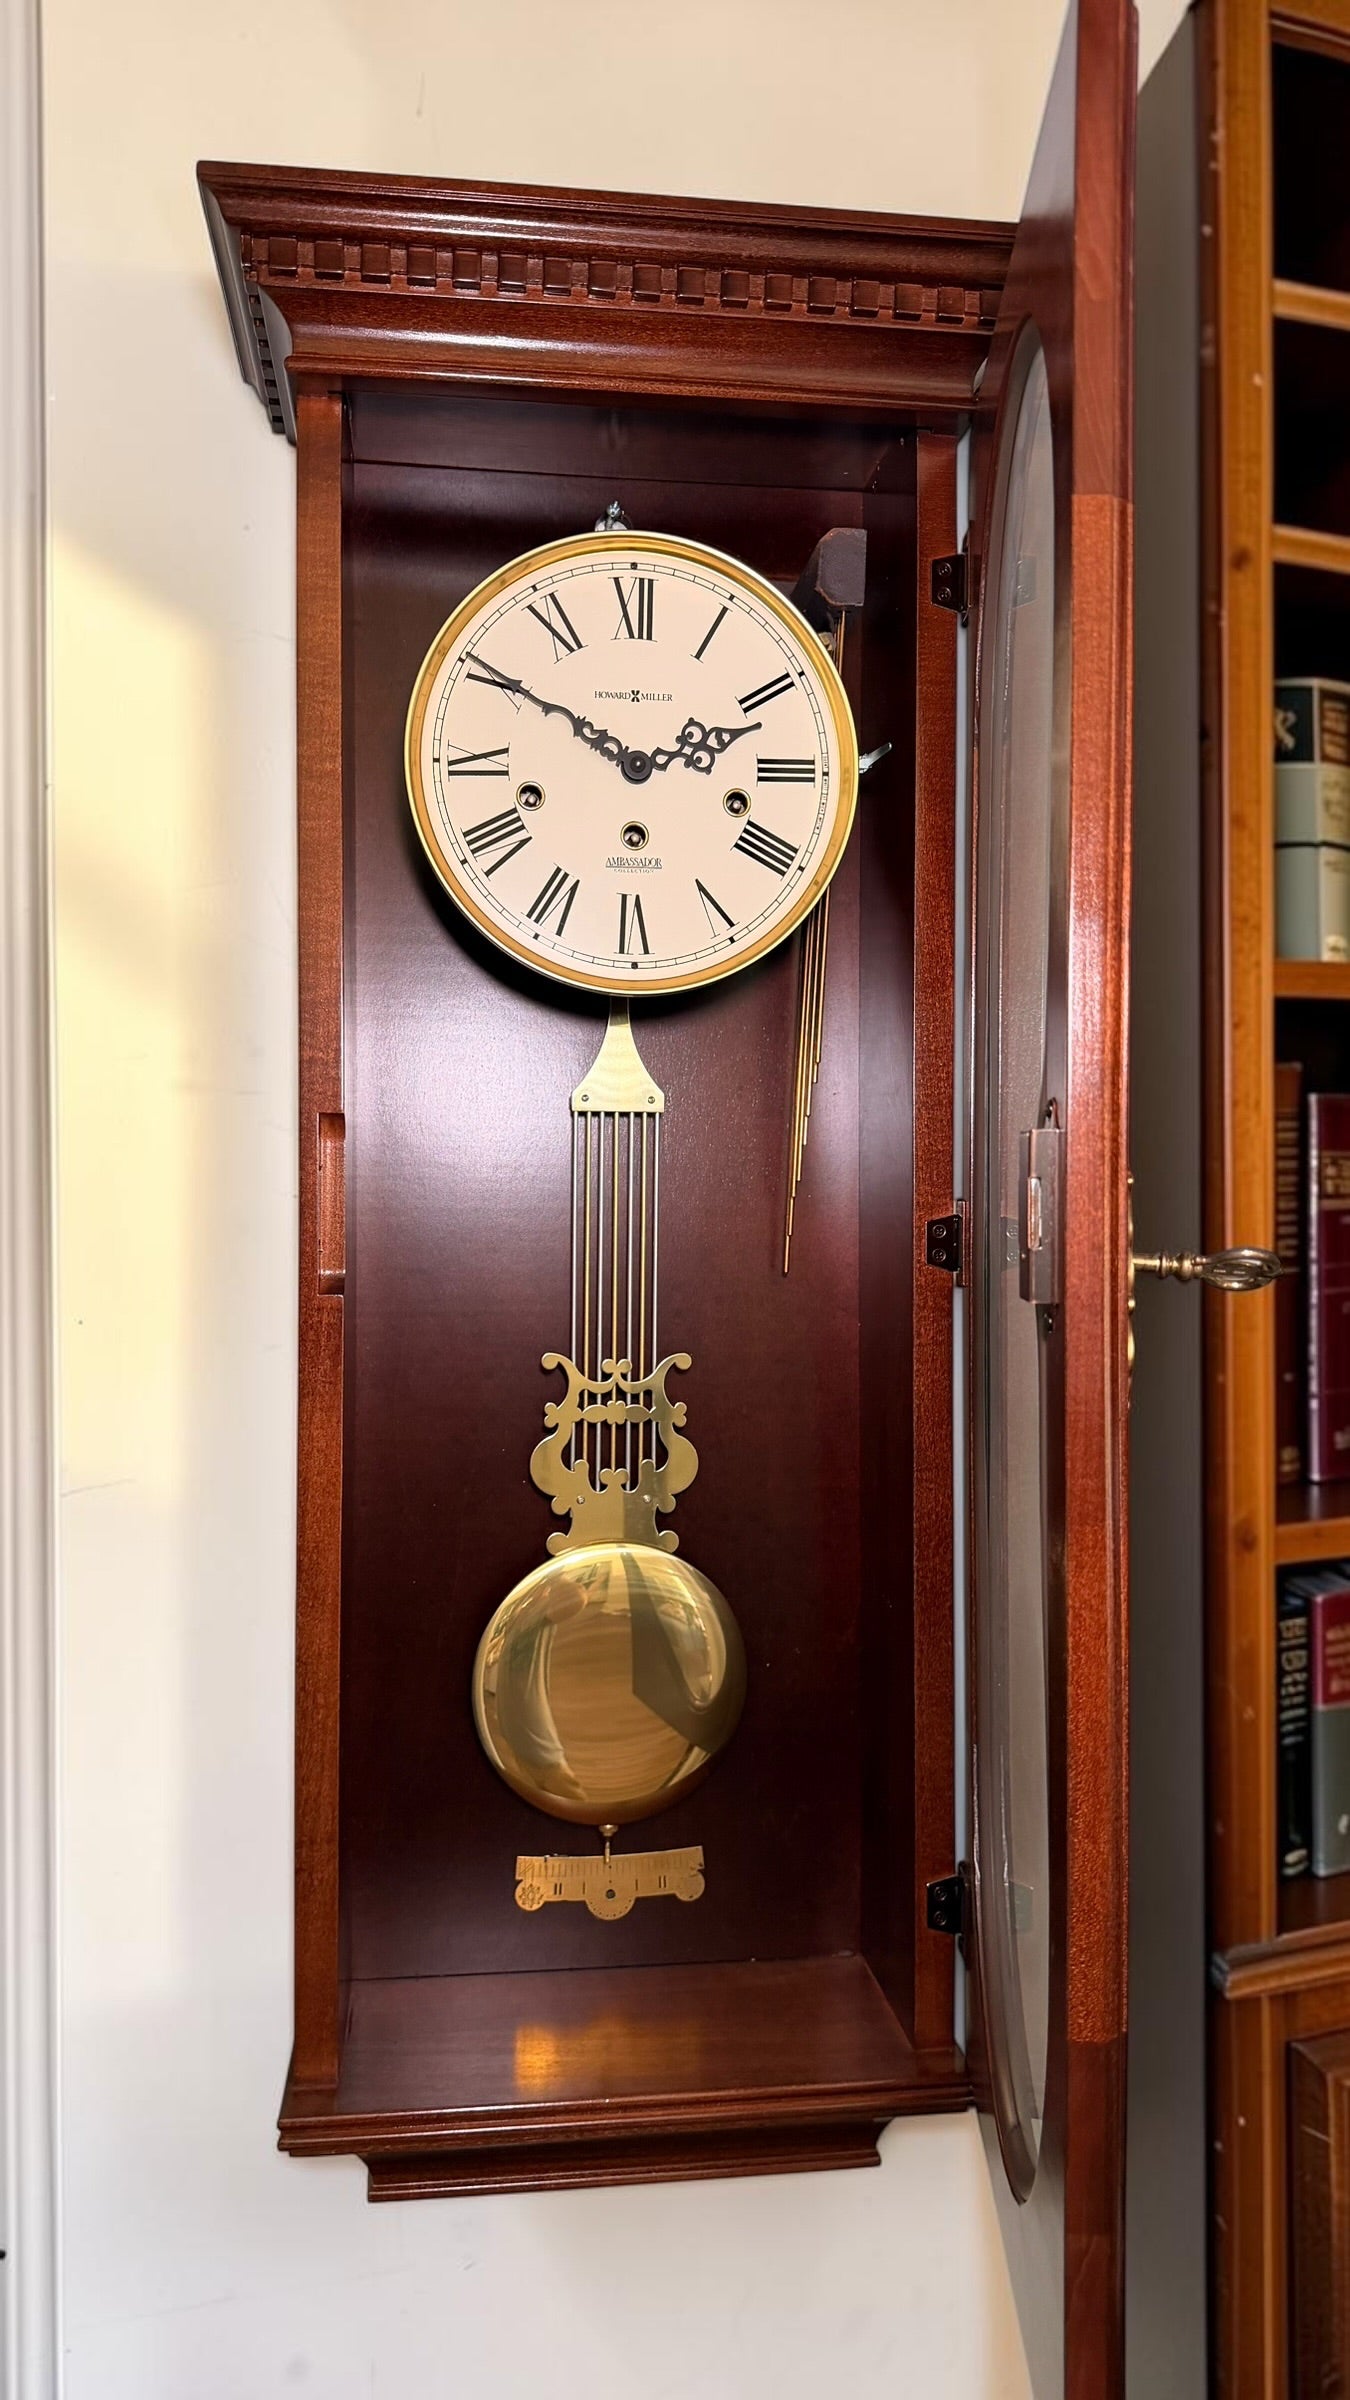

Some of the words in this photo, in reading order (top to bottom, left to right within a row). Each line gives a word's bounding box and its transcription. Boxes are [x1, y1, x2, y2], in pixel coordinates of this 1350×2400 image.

[521, 591, 589, 664] XI
[607, 576, 660, 643] XII
[690, 602, 735, 663] I
[464, 654, 533, 714] X
[594, 690, 631, 700] HOWARD
[641, 693, 673, 702] MILLER
[737, 667, 796, 718] II
[447, 739, 511, 782] IX
[756, 753, 817, 788] III
[461, 807, 533, 881] VIII
[605, 856, 662, 868] AMBASSADOR
[733, 815, 802, 881] IIII
[522, 863, 581, 938] VII
[614, 892, 656, 956] VI
[695, 878, 740, 938] V
